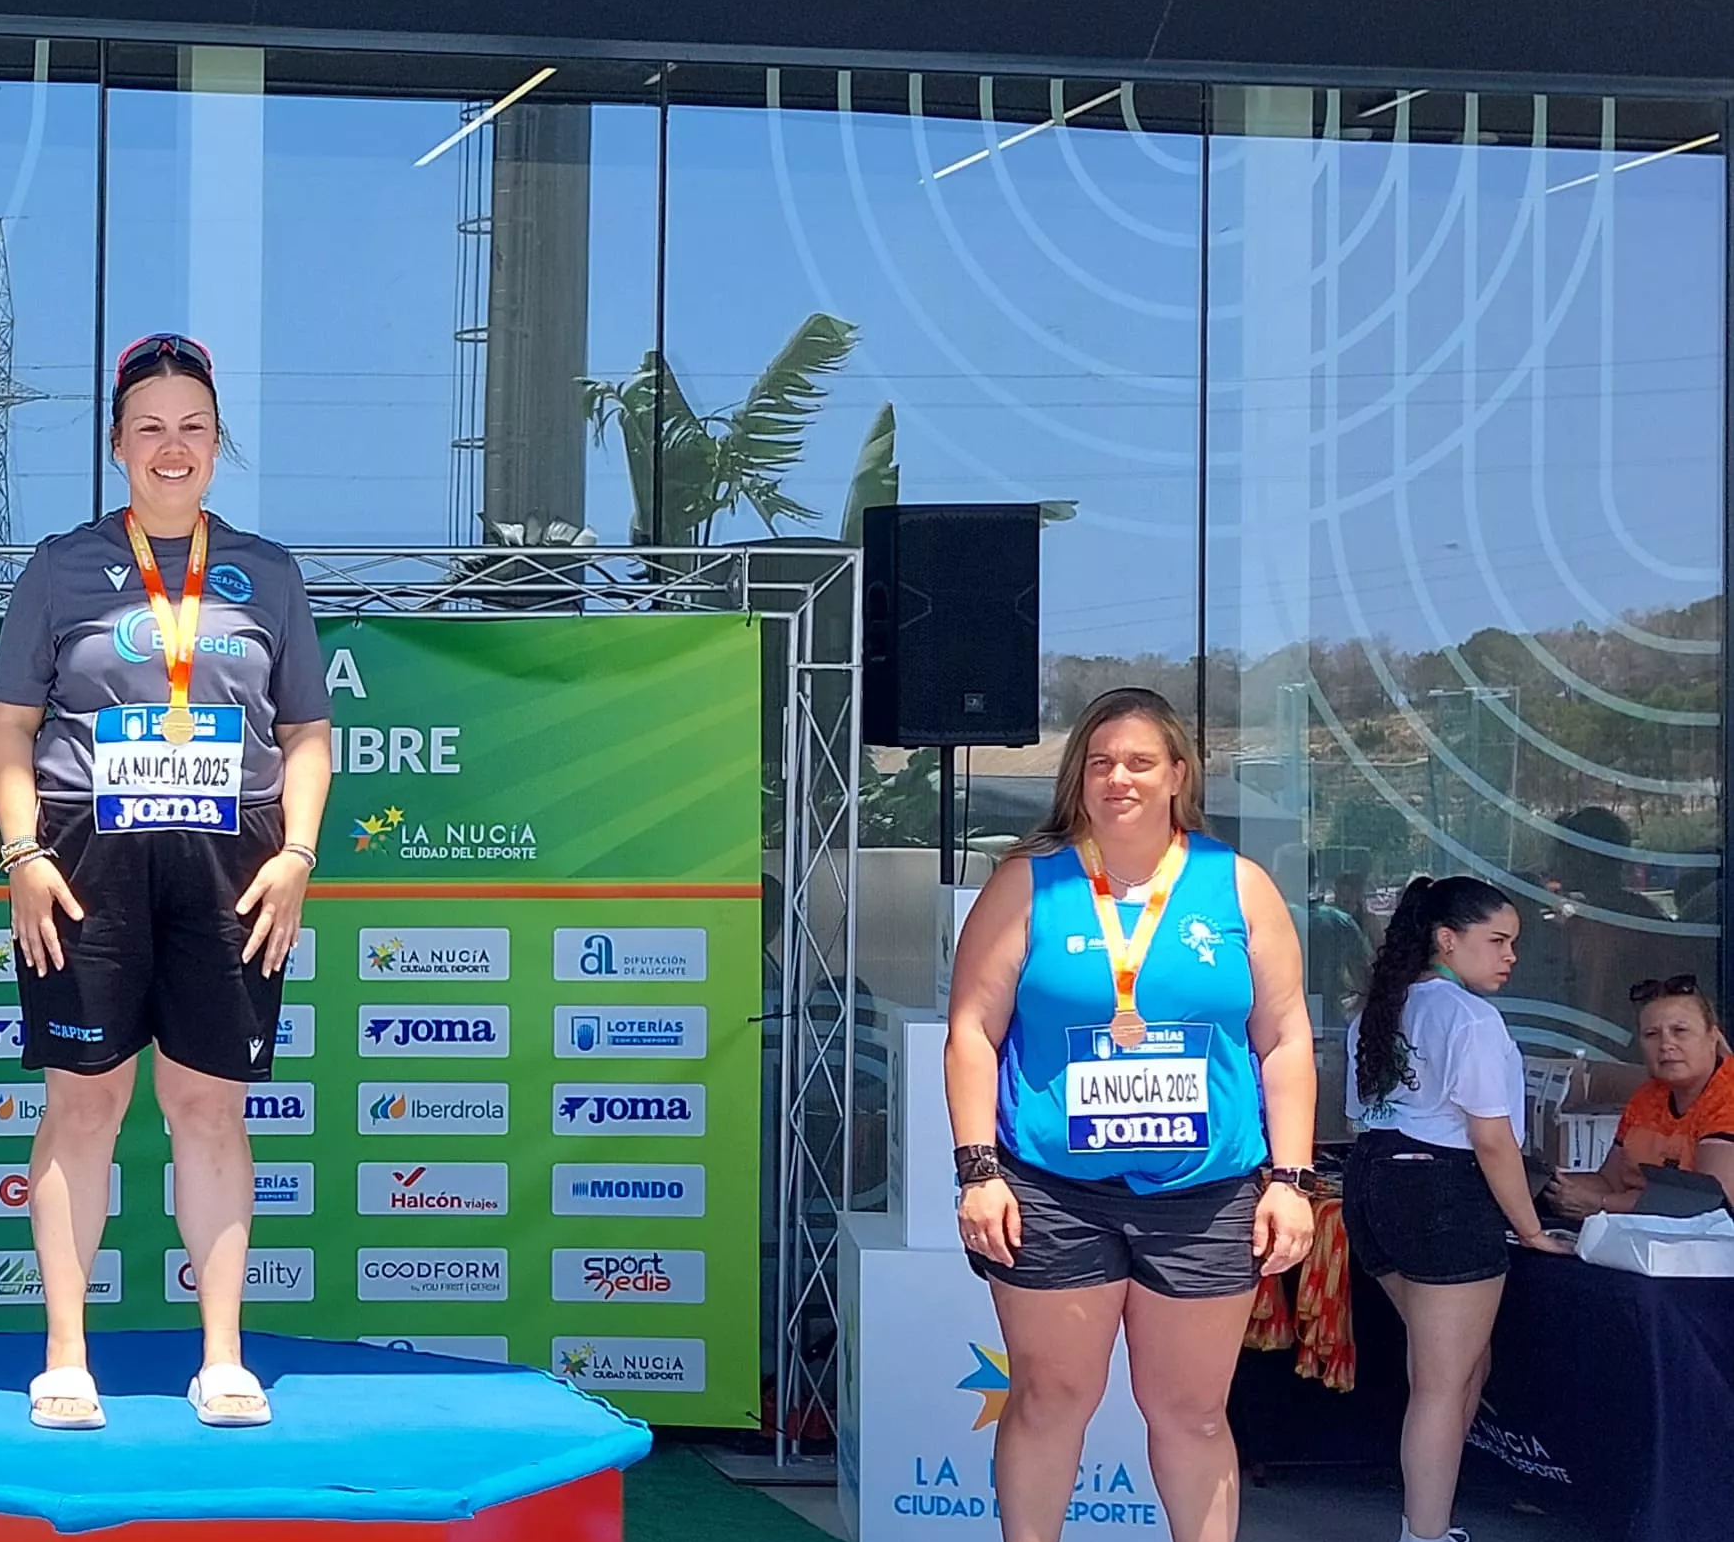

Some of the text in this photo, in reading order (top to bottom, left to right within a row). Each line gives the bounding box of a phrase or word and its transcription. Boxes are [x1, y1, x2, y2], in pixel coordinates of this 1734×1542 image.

[331, 727, 460, 774] IBRE
[108, 748, 231, 786] LA NUCÍA 2025
[401, 824, 429, 844] LA
[400, 846, 537, 859] CIUDAD DEL DEPORTE
[400, 951, 420, 963] LA
[607, 1019, 683, 1033] LOTERÍAS
[1081, 1067, 1199, 1105] LA NUCÍA 2025
[244, 1096, 306, 1119] ma
[411, 1100, 504, 1119] Iberdrola
[590, 1180, 683, 1199] MONDO
[391, 1191, 498, 1210] Halcón viajes
[365, 1262, 499, 1278] GOODFORM
[593, 1355, 612, 1370] LA
[593, 1370, 625, 1380] CIUDAD
[916, 1457, 959, 1487] LA
[894, 1495, 985, 1517] CIUDAD
